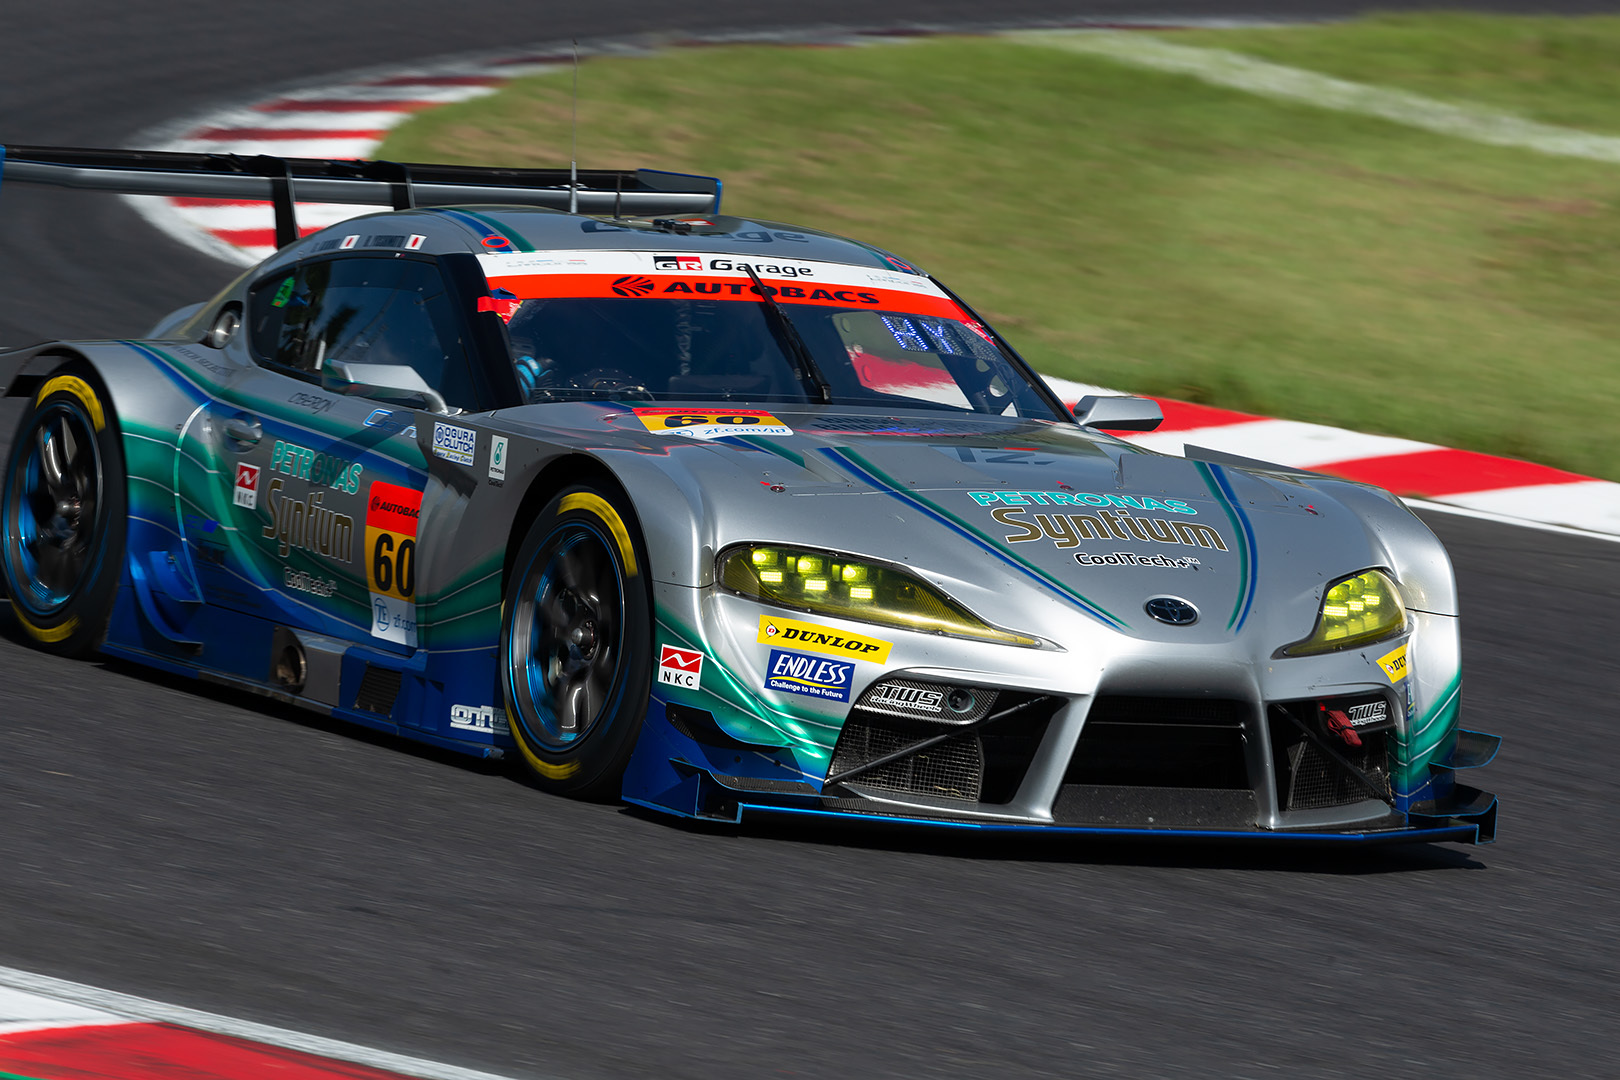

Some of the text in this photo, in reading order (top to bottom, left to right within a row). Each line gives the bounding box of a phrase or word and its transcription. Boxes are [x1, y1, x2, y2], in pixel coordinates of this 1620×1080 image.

[655, 258, 814, 278] GR Garage
[664, 281, 879, 304] AUTOBACS
[664, 415, 761, 428] 60
[444, 427, 475, 443] OGURA
[444, 438, 474, 454] CLUTCH
[269, 440, 364, 495] PETRONAS
[967, 491, 1198, 515] PETRONAS
[262, 477, 355, 564] Syntium
[991, 507, 1229, 552] Syntium
[374, 533, 416, 598] 60
[781, 627, 880, 654] DUNLOP
[773, 654, 851, 685] ENDLESS
[770, 680, 843, 699] Challenge to the Future
[876, 683, 943, 707] TWS
[1348, 701, 1387, 721] TWS
